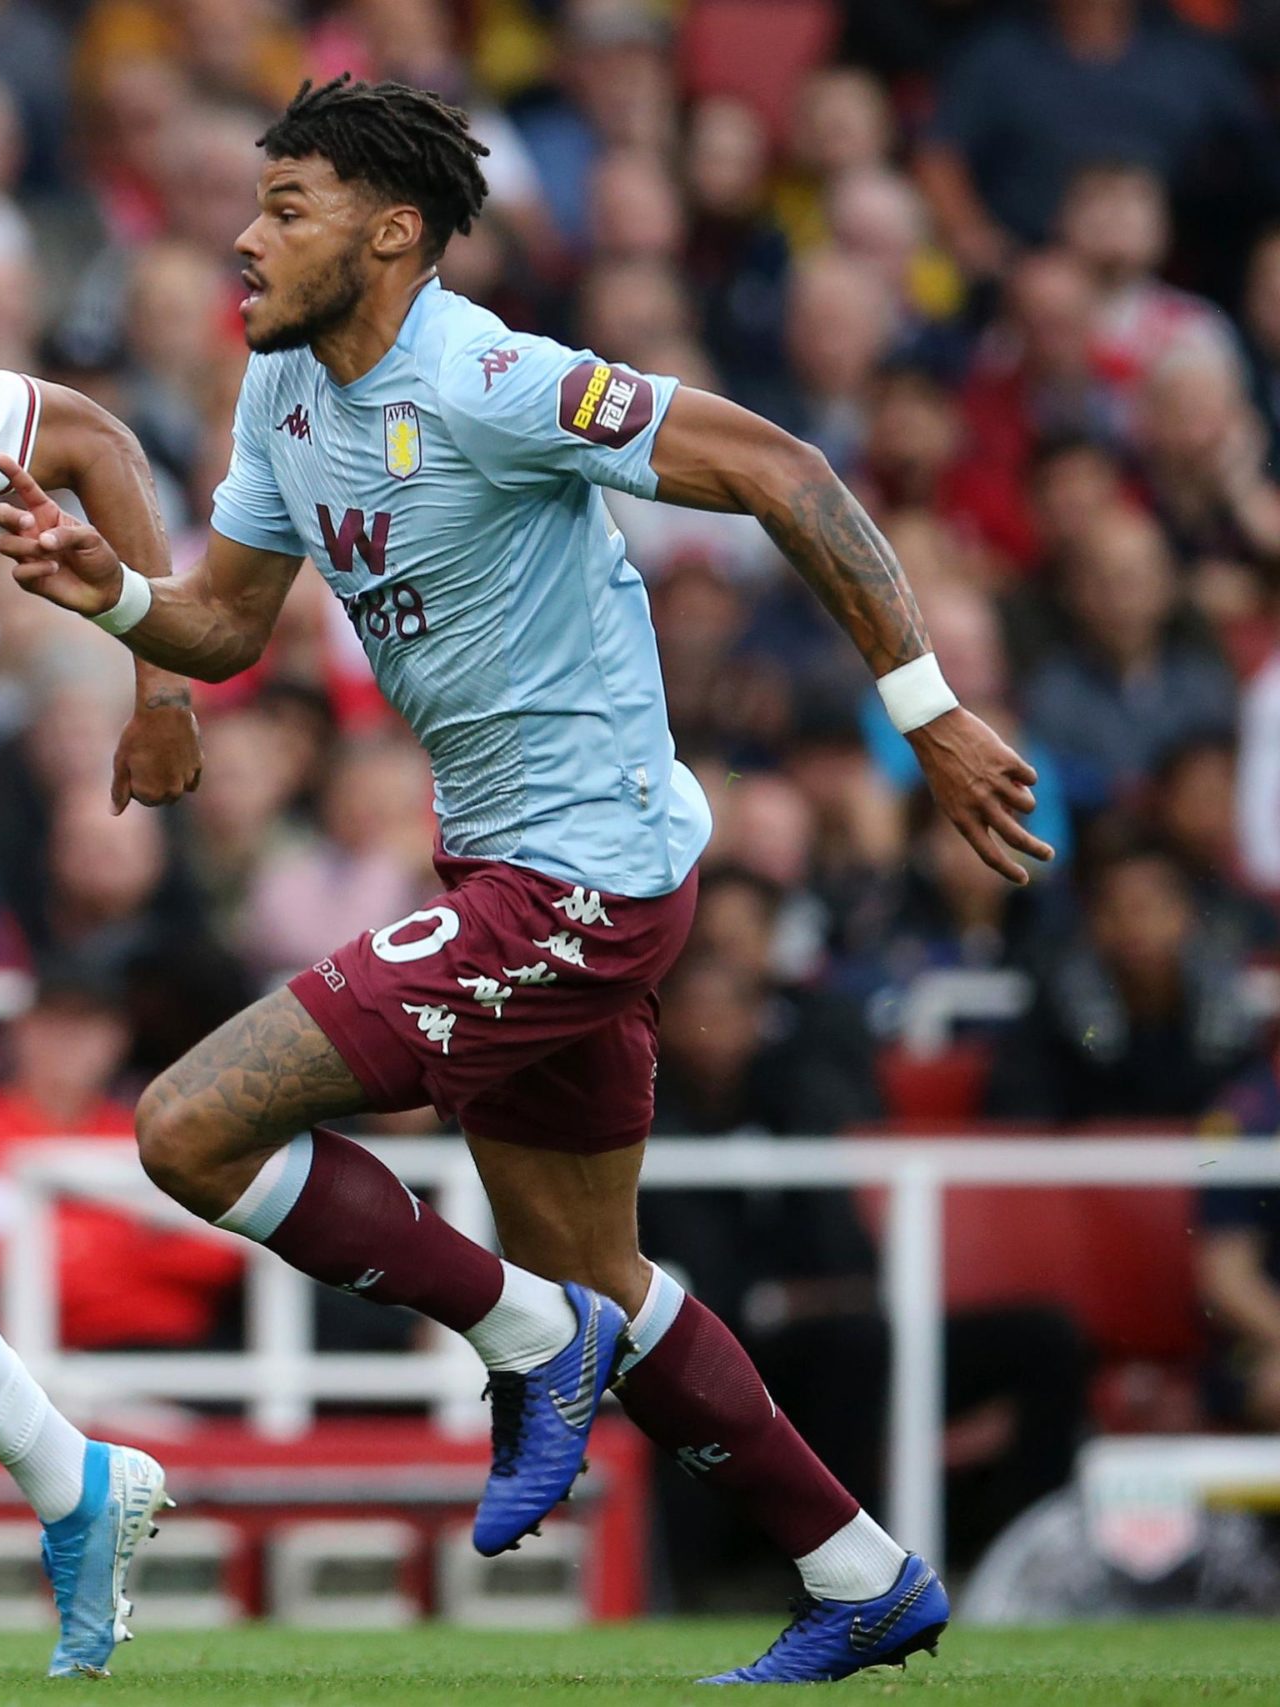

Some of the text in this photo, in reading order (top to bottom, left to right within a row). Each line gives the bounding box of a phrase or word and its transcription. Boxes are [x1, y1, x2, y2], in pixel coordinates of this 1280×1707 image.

[387, 404, 416, 421] AVFC
[572, 365, 612, 430] BR88
[315, 503, 391, 576] W
[371, 906, 460, 963] 0
[313, 957, 346, 992] pa
